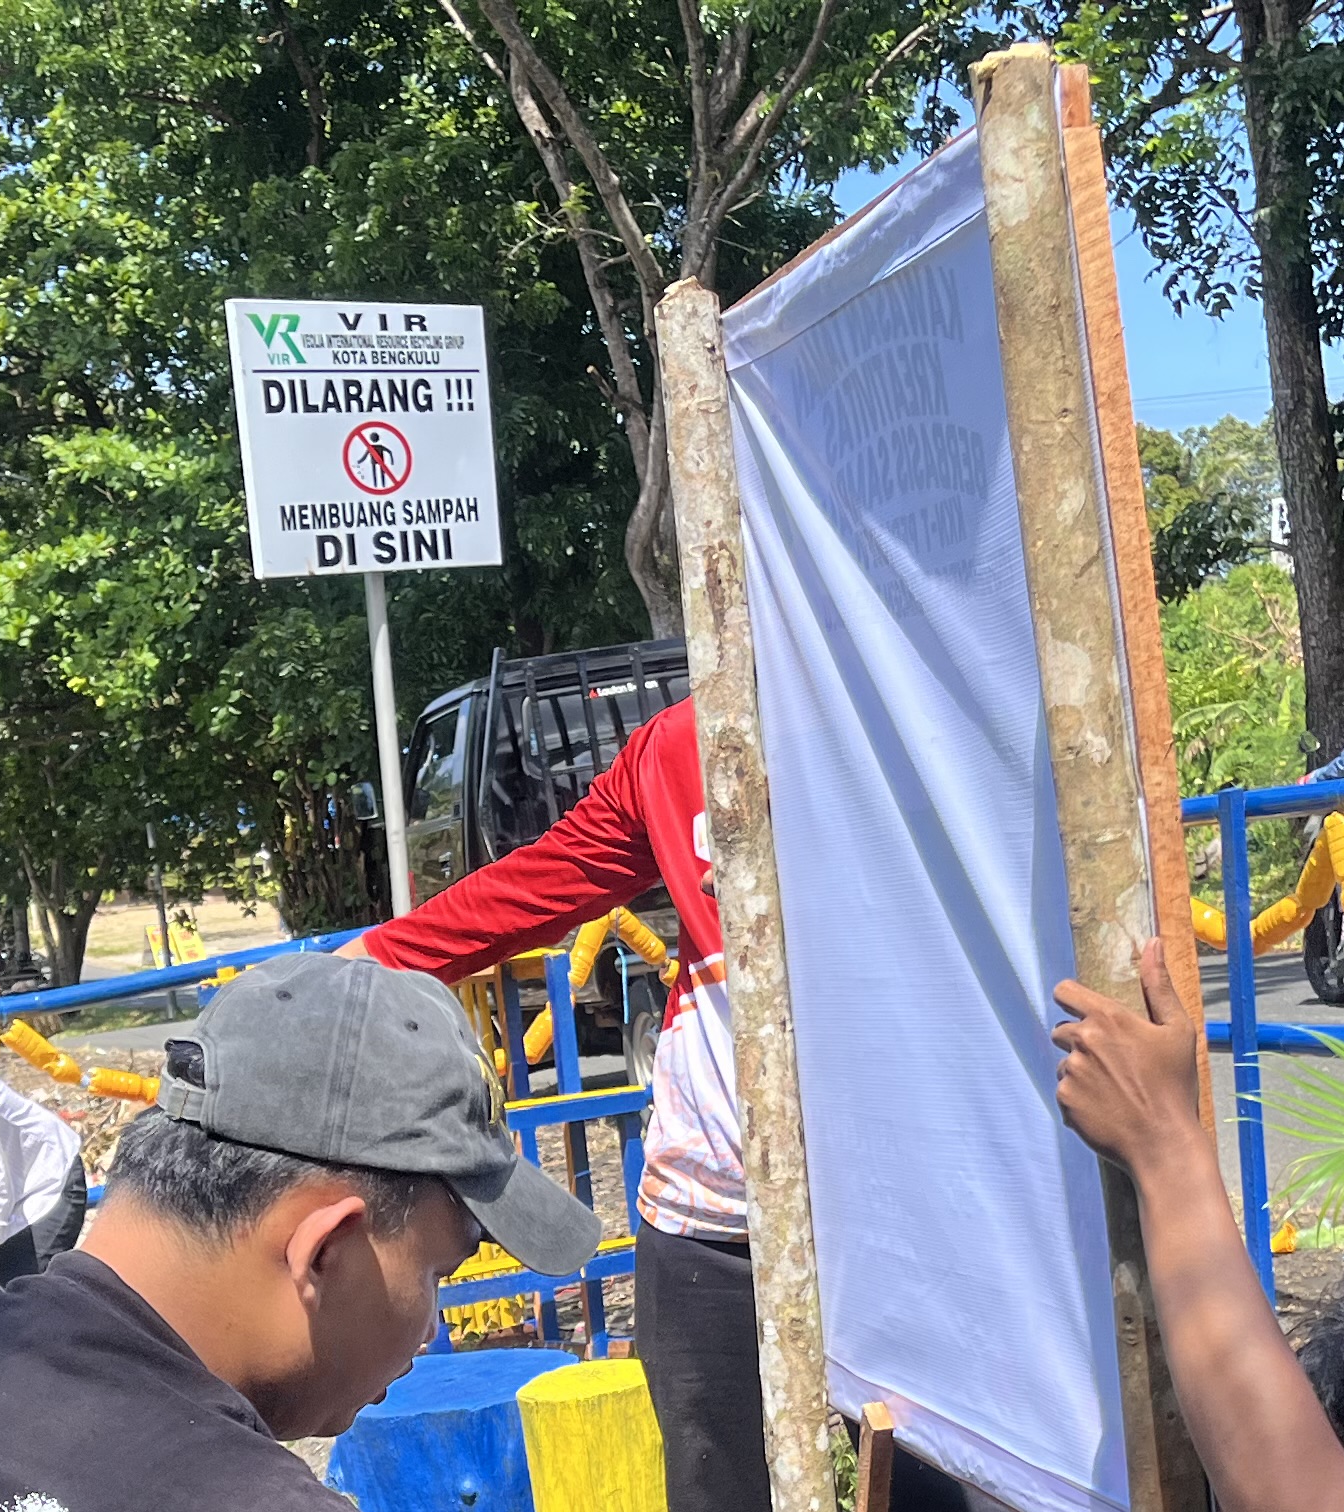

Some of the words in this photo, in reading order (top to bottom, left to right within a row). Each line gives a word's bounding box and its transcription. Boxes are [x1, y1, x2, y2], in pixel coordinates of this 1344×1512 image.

[267, 352, 290, 366] VIR
[332, 350, 368, 365] KOTA
[372, 350, 440, 365] BENGKULU
[262, 378, 434, 414] DILARANG
[280, 501, 396, 531] MEMBUANG
[402, 497, 479, 525] SAMPAH
[316, 532, 358, 568] DI
[372, 528, 454, 564] SINI
